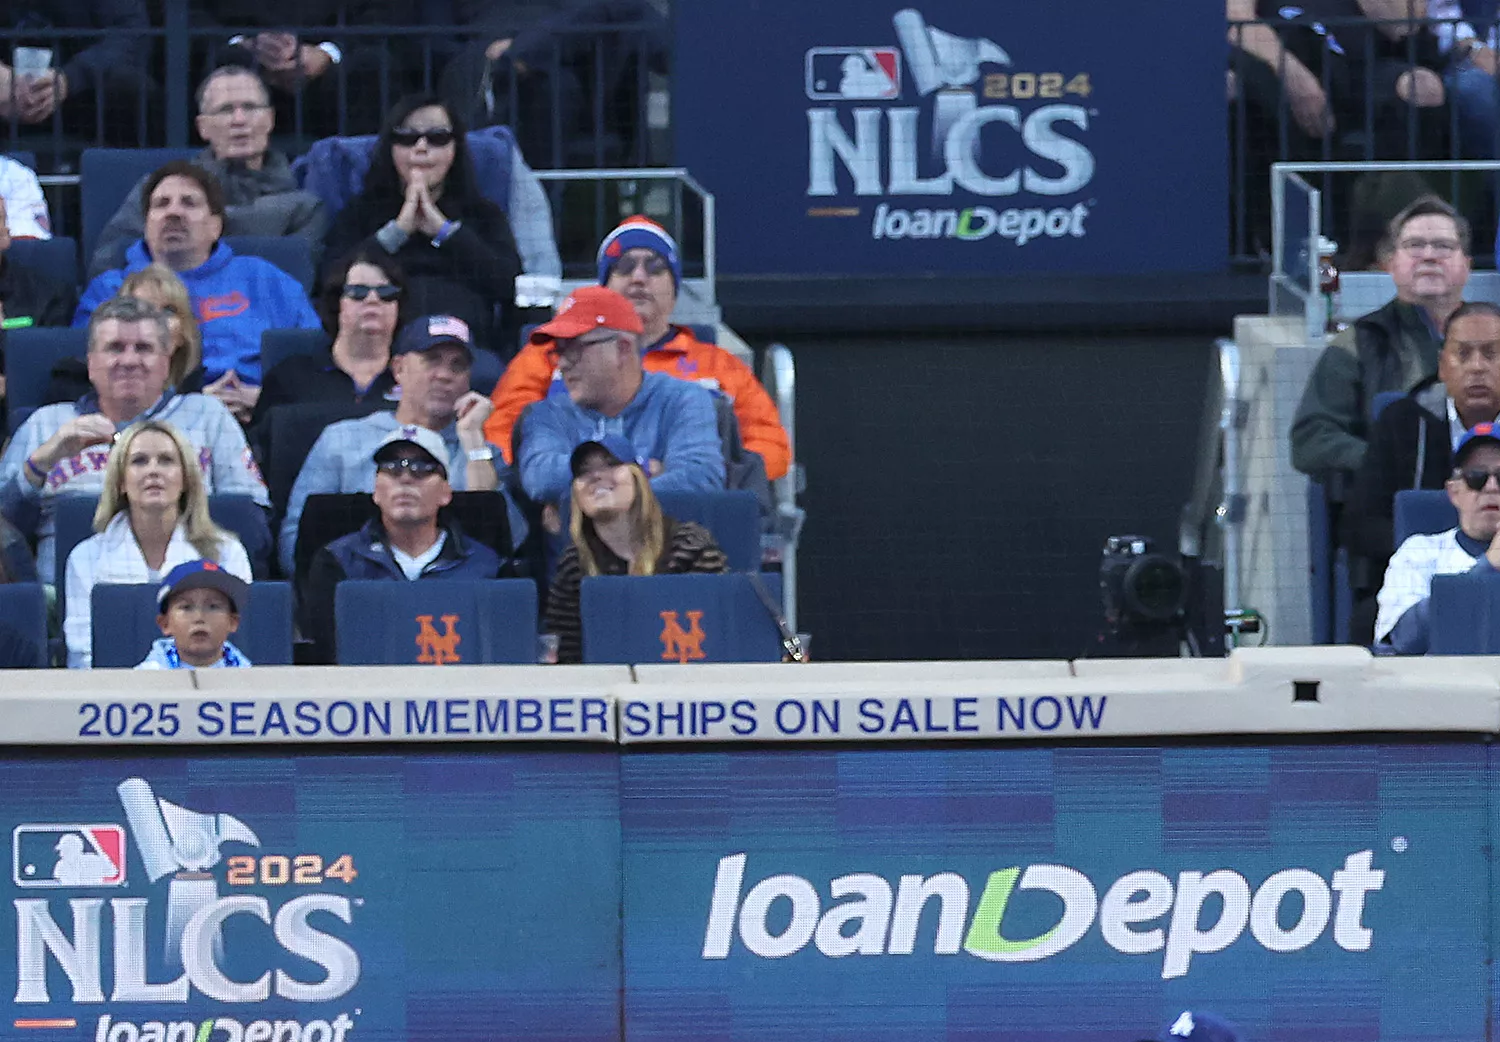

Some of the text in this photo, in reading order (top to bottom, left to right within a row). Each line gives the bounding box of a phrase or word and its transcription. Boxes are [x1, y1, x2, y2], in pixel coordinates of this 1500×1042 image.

[983, 73, 1092, 98] 2024
[806, 104, 1096, 196] NLCS
[872, 203, 1089, 246] loanDepot
[79, 702, 181, 738] 2025
[197, 700, 392, 737] SEASON
[774, 698, 841, 735] ON
[858, 697, 980, 734] SALE
[997, 695, 1108, 732] NOW
[226, 854, 358, 884] 2024
[701, 849, 1386, 979] loanDepot
[13, 893, 362, 1003] NLCS
